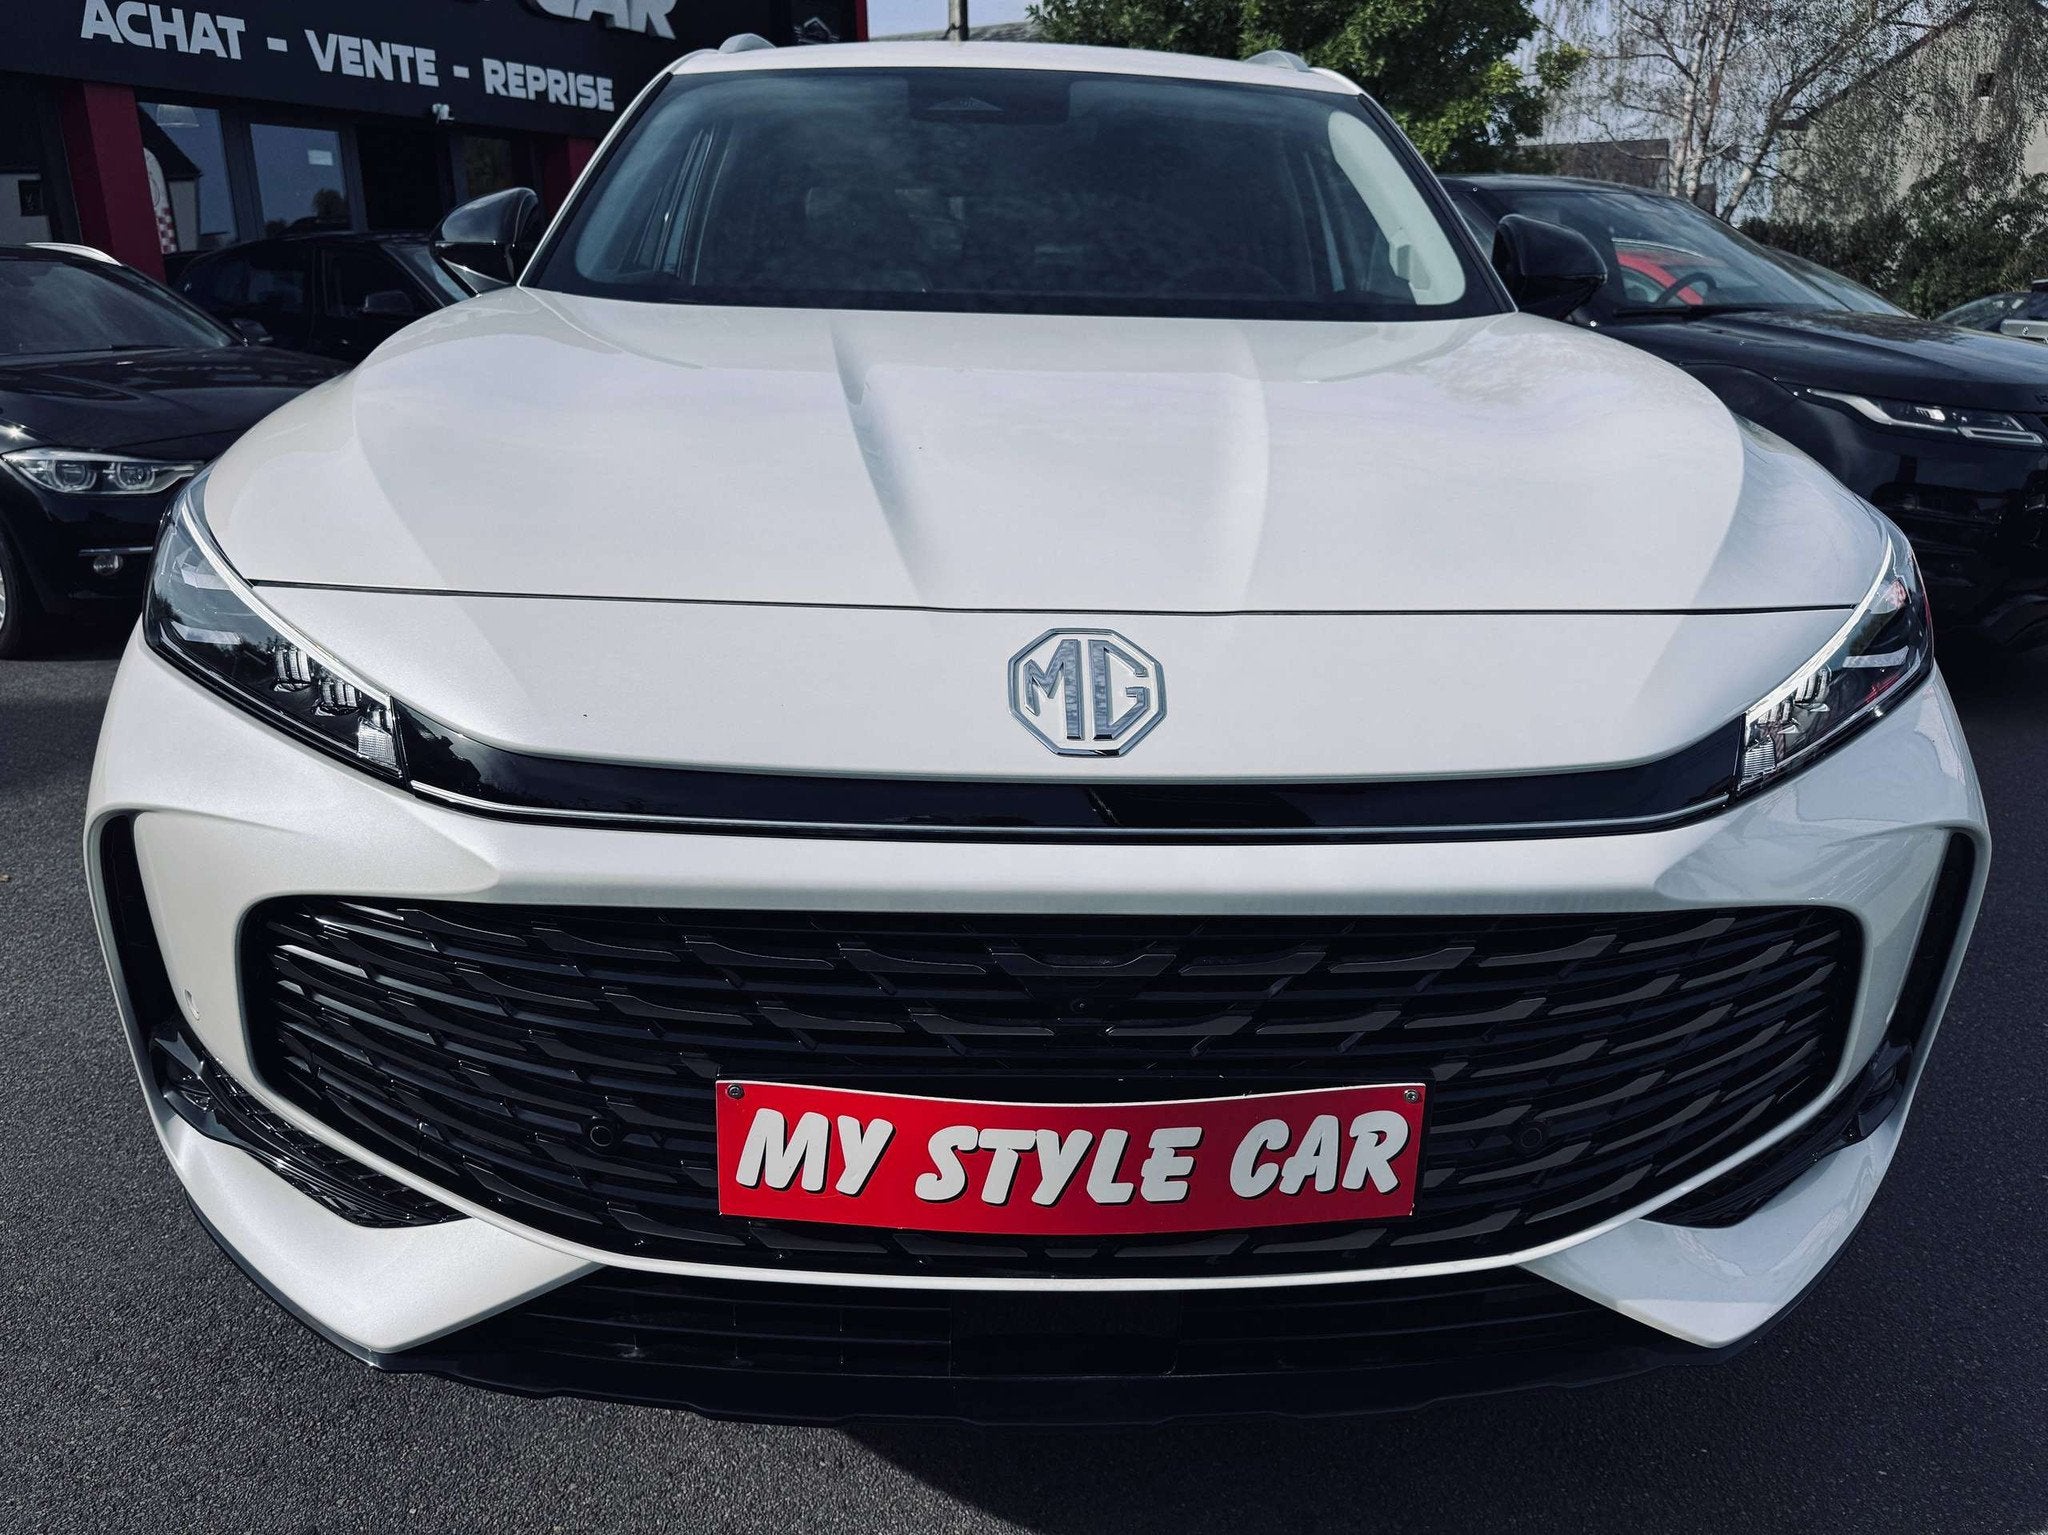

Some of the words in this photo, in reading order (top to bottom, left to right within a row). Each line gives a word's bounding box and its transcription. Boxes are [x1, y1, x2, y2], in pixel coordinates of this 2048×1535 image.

[80, 0, 246, 60] ACHAT
[304, 29, 439, 87] VENTE
[482, 57, 615, 112] REPRISE
[1022, 638, 1151, 742] MG
[735, 1107, 895, 1197] MY
[914, 1125, 1203, 1206] STYLE
[1229, 1110, 1410, 1198] CAR
